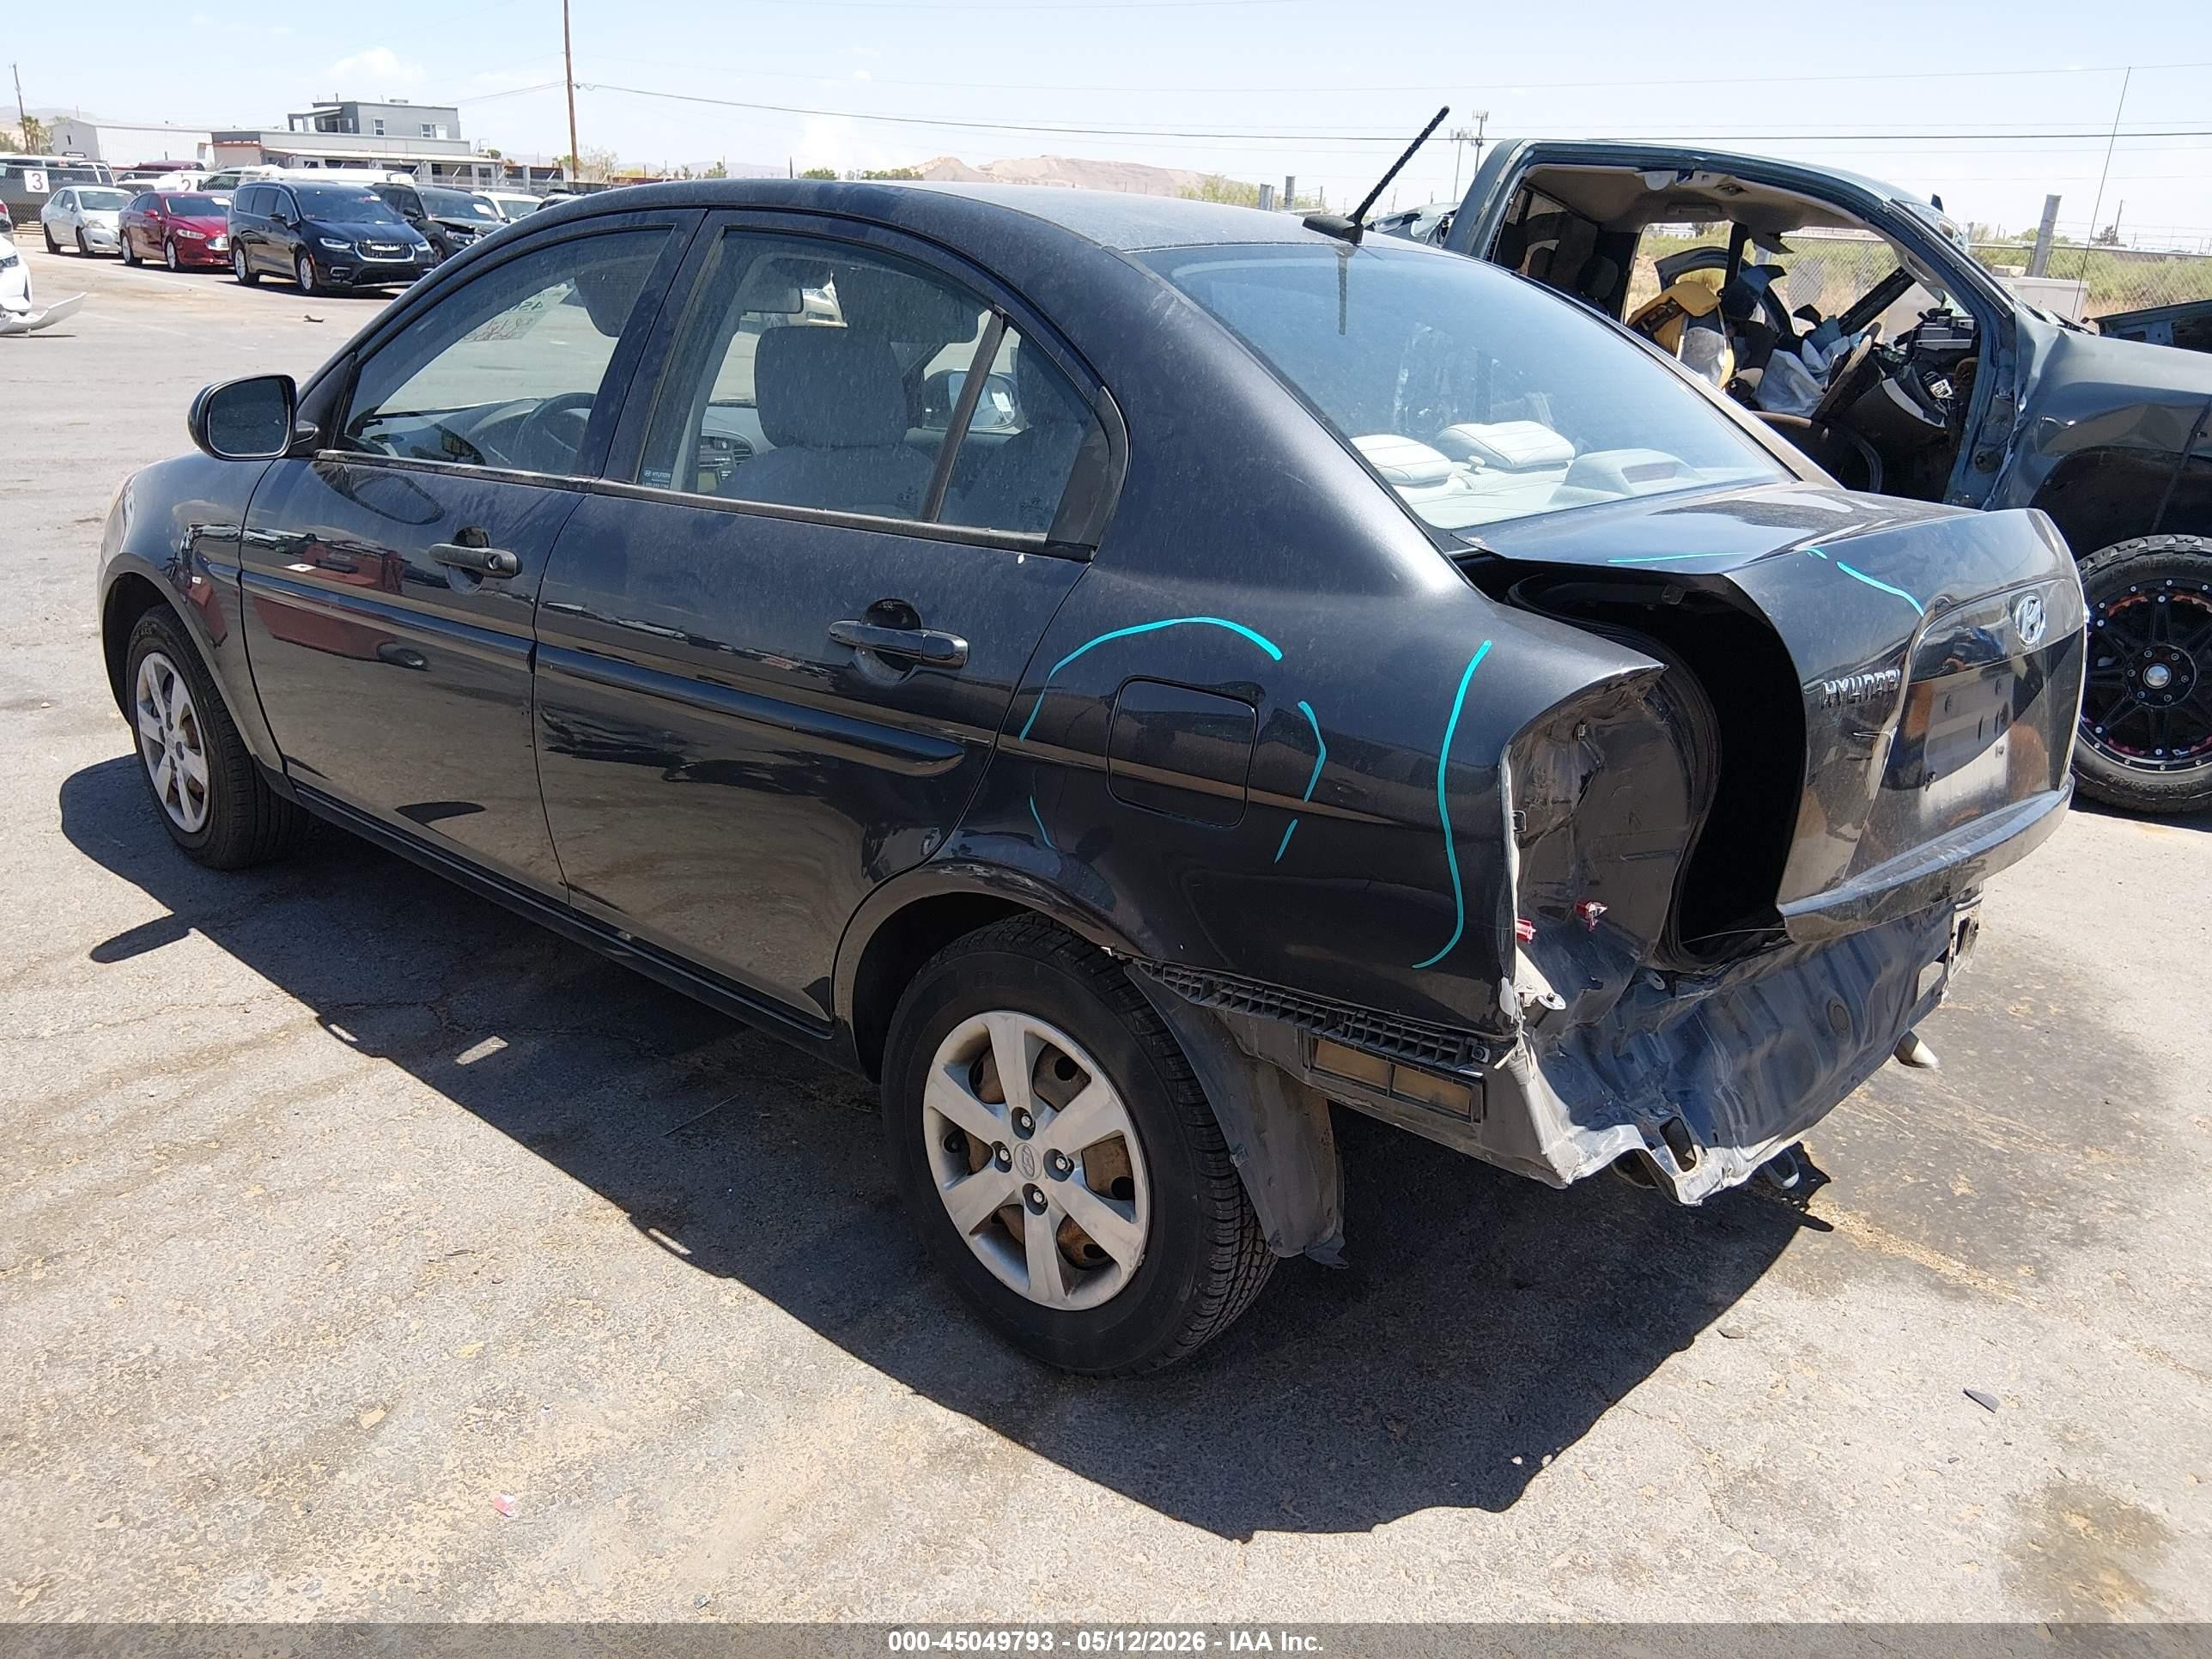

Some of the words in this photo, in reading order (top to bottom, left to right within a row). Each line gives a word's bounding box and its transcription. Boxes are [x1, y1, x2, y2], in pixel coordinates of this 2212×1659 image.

[32, 173, 43, 191] 3
[181, 179, 191, 191] 2
[1820, 668, 1900, 708] HYUNDAI
